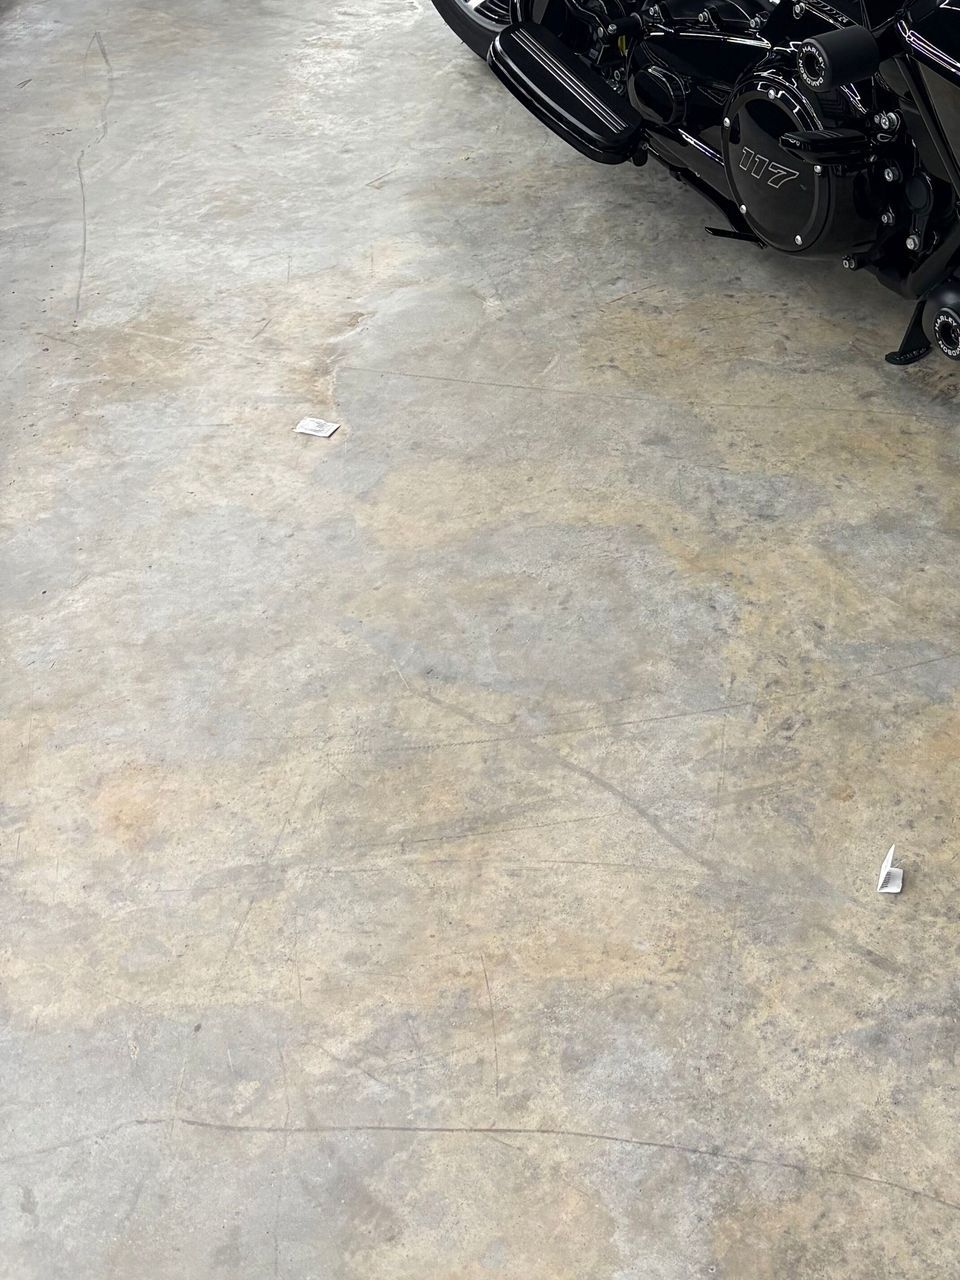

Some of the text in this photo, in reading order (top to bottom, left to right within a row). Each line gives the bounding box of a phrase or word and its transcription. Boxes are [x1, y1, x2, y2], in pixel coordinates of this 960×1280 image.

[802, 45, 825, 69] HARLEY
[739, 146, 799, 189] 117
[935, 315, 957, 331] HARLEY
